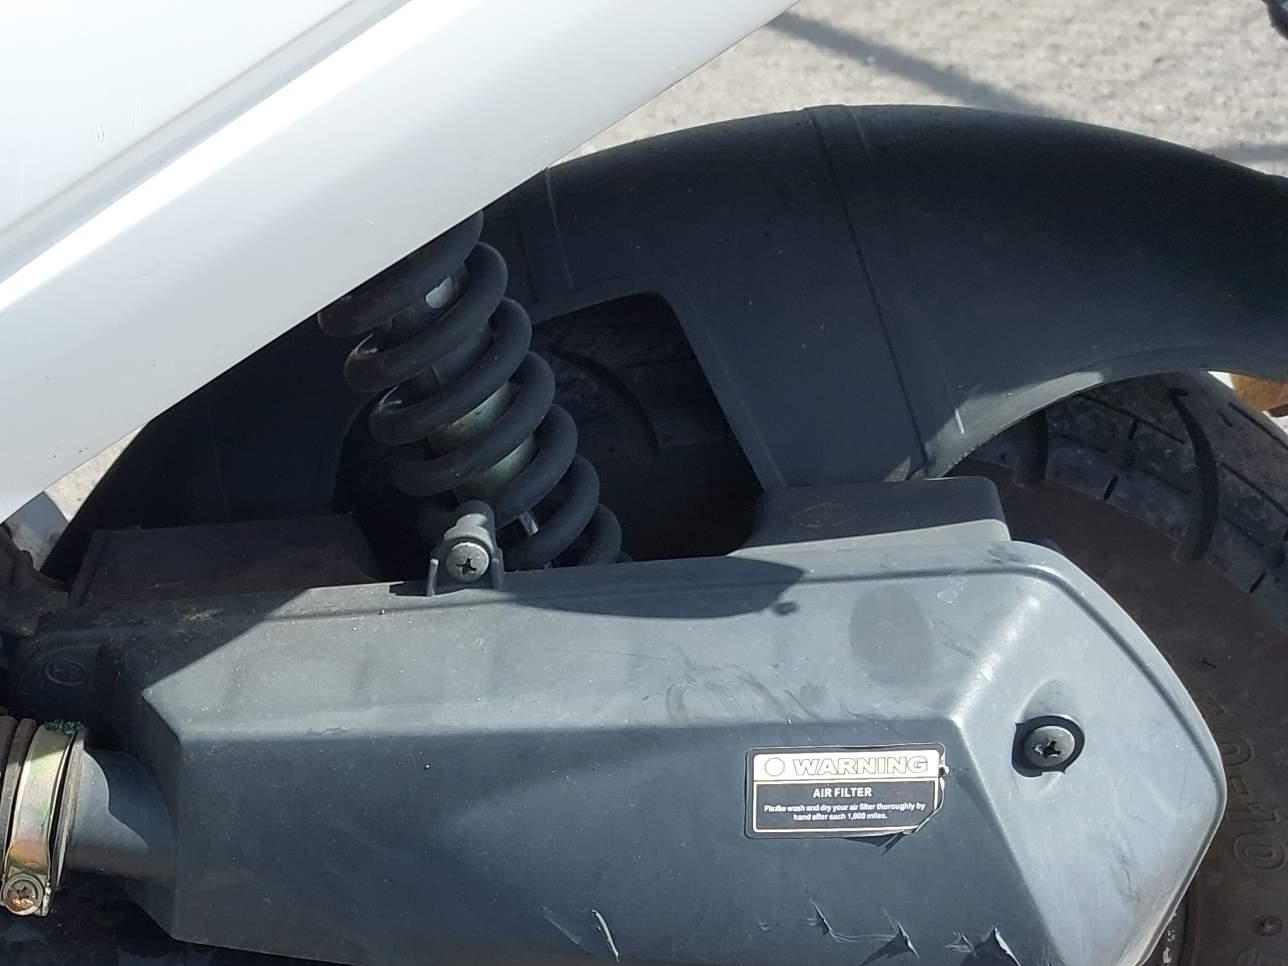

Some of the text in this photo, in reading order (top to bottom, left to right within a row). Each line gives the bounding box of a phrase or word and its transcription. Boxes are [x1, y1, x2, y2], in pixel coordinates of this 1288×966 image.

[793, 756, 929, 776] WARNING
[813, 787, 872, 798] AIR FILTER
[806, 804, 819, 812] and
[820, 804, 832, 813] dry
[832, 804, 848, 813] your
[876, 802, 915, 811] thoroughly
[916, 802, 926, 811] by
[828, 812, 846, 820] each
